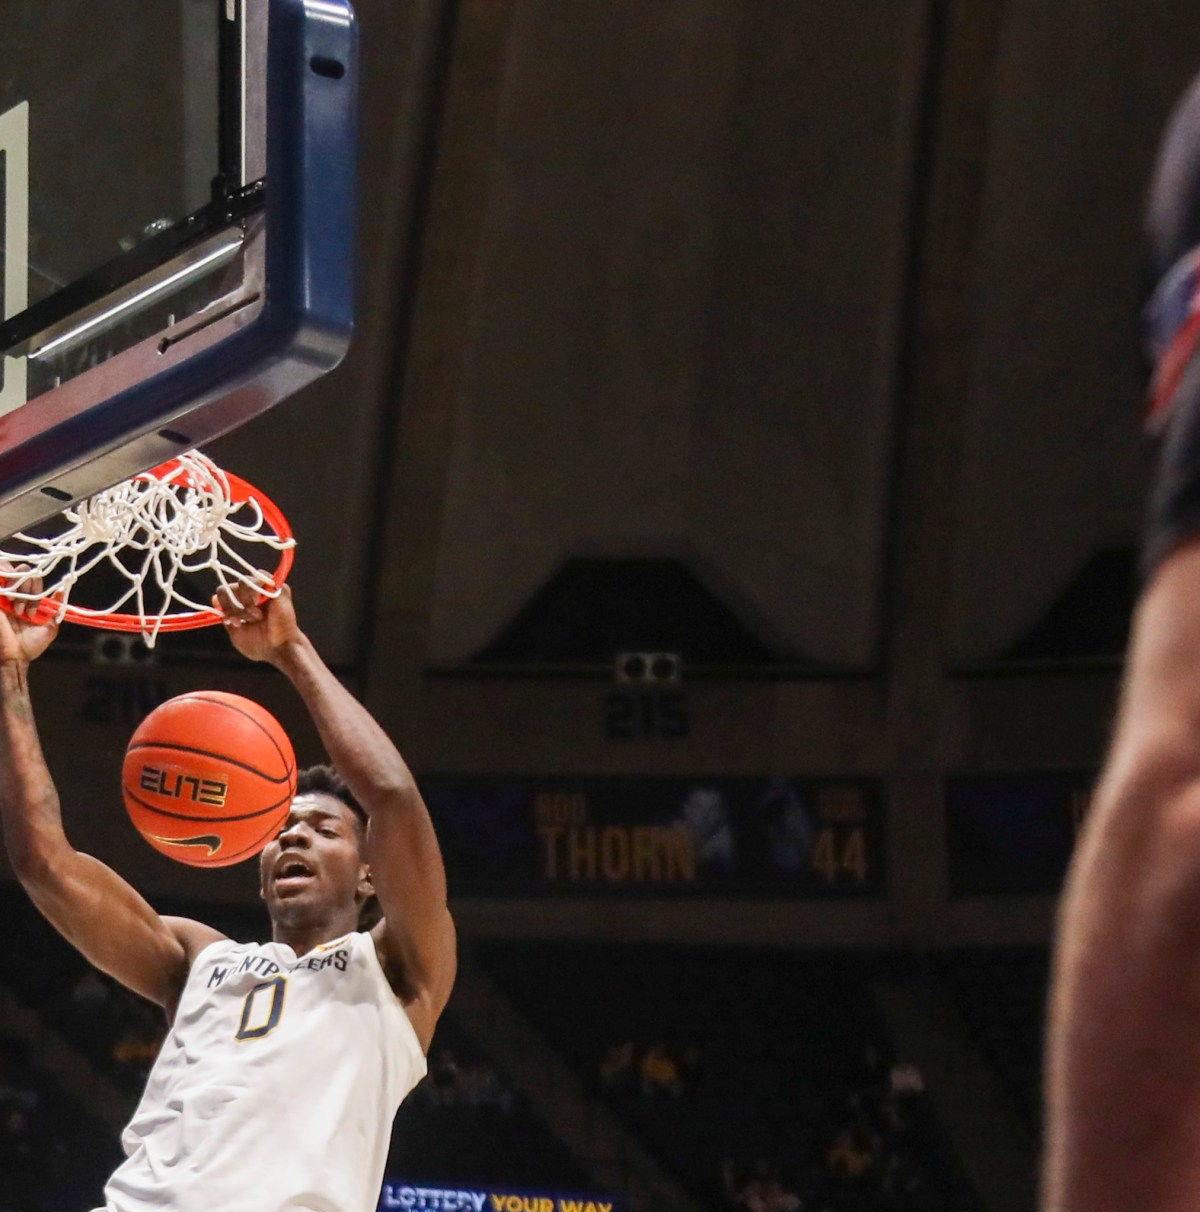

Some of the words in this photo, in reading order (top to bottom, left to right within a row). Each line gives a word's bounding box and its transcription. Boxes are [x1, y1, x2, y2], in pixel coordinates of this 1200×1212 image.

[537, 825, 696, 882] THORN
[812, 829, 868, 881] 44
[234, 974, 288, 1043] 0
